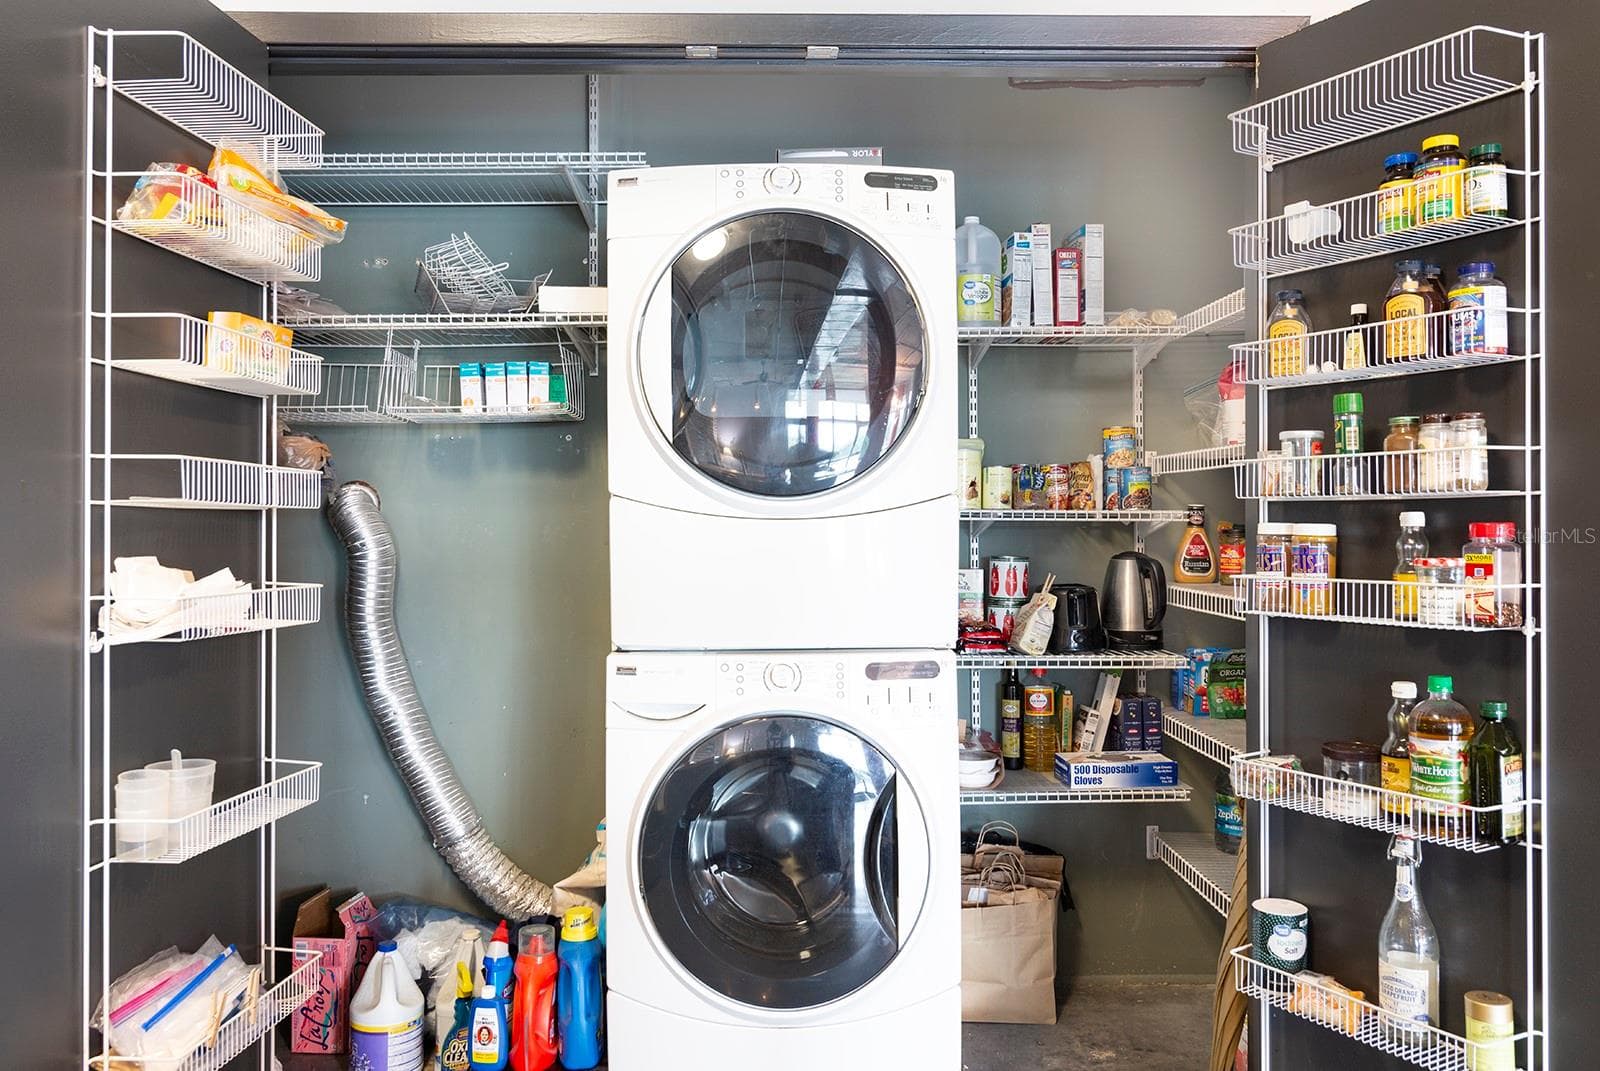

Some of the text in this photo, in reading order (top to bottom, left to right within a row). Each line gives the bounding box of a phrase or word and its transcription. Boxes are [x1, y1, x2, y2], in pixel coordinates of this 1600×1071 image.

[852, 149, 882, 158] TAYLOR
[1390, 307, 1418, 320] LOCAL
[1183, 560, 1210, 568] Russian
[1073, 764, 1091, 775] 500
[1092, 763, 1139, 775] Disposable
[1073, 776, 1103, 786] Gloves
[1217, 807, 1242, 823] Zephy
[1284, 946, 1298, 955] Salt
[1394, 986, 1418, 997] ORANGE
[445, 1051, 469, 1063] CLEA
